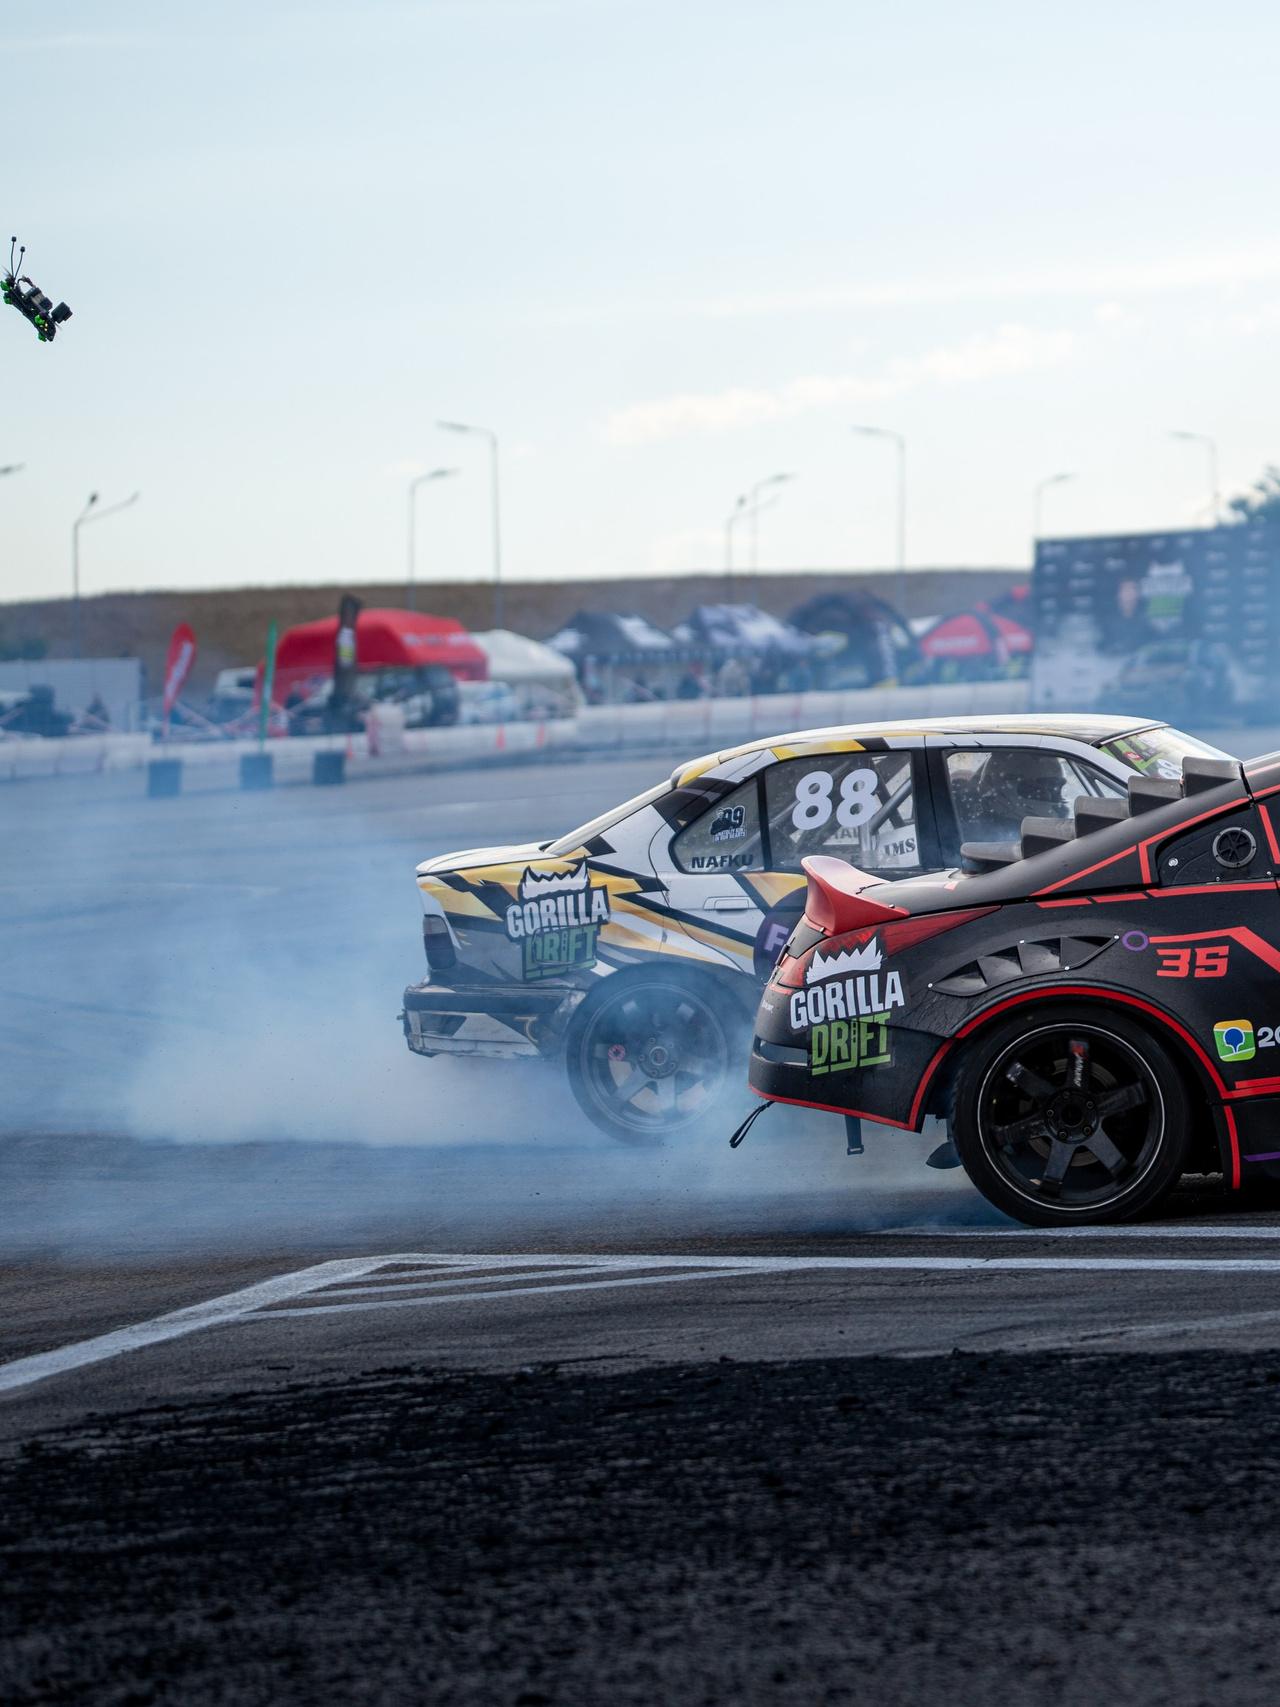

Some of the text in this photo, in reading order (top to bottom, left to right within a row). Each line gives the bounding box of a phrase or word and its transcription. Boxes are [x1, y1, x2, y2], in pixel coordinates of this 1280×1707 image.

[792, 768, 878, 830] 88
[691, 854, 754, 869] NAFKU
[506, 889, 610, 938] GORILLA
[525, 924, 598, 978] DRIFT
[1156, 945, 1230, 978] 35
[790, 970, 905, 1030] GORILLA
[811, 1012, 891, 1076] DRIFT
